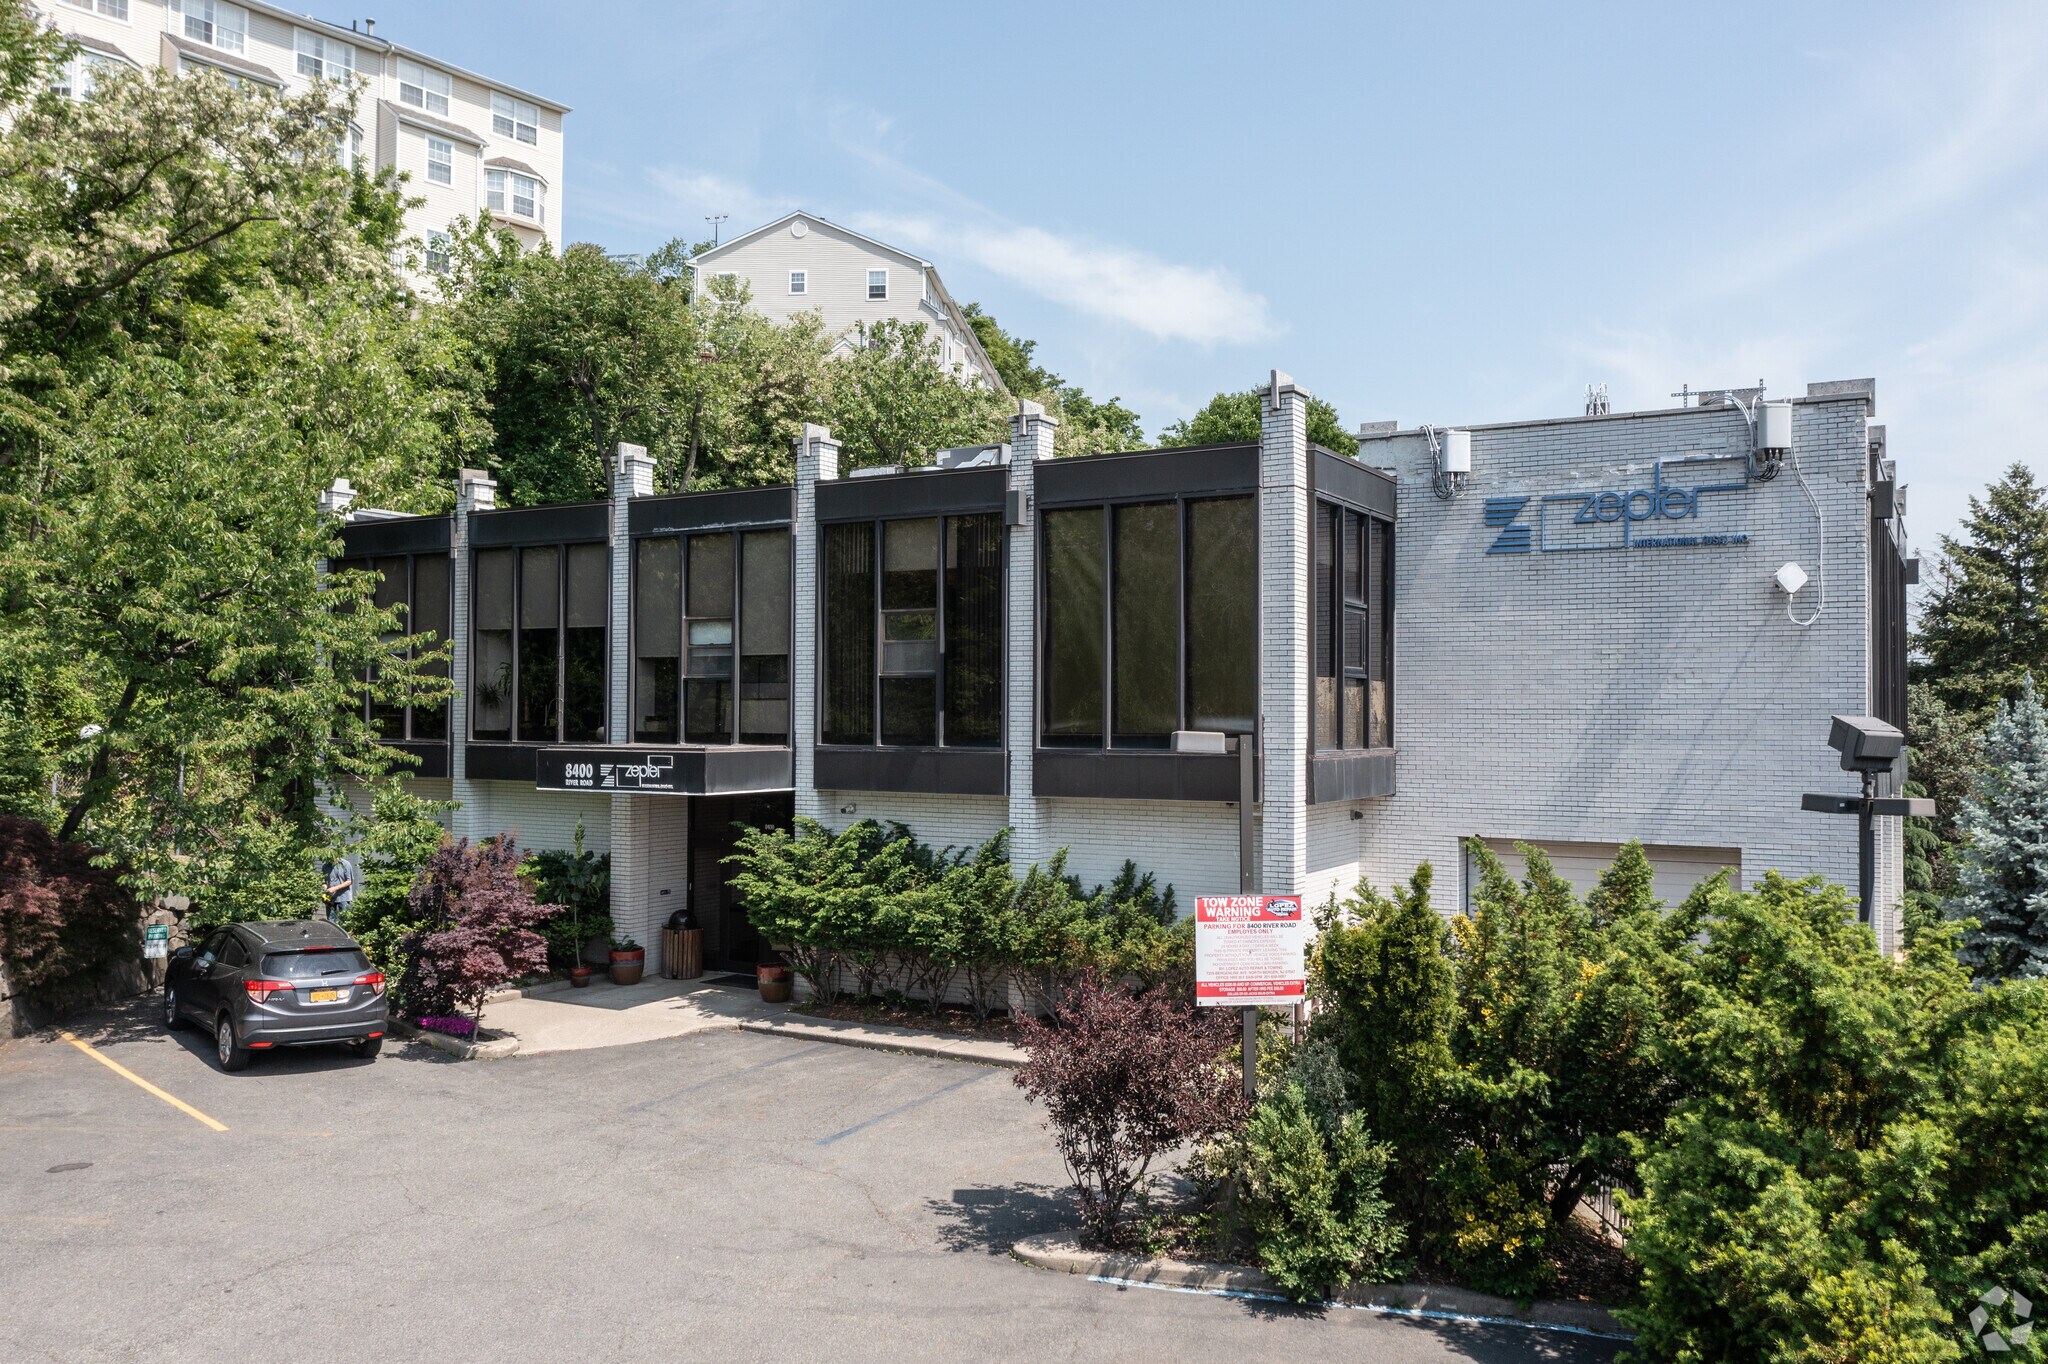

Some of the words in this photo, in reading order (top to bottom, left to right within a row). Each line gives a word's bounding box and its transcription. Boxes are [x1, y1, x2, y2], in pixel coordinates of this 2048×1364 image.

[1574, 462, 1699, 548] zepter
[1633, 536, 1698, 548] INTERNATIONAL
[1702, 535, 1728, 546] (USA)
[565, 763, 593, 778] 8400
[625, 756, 660, 787] zepter
[1202, 898, 1229, 908] TOW
[1231, 897, 1263, 906] ZONE
[1206, 907, 1260, 917] WARNING
